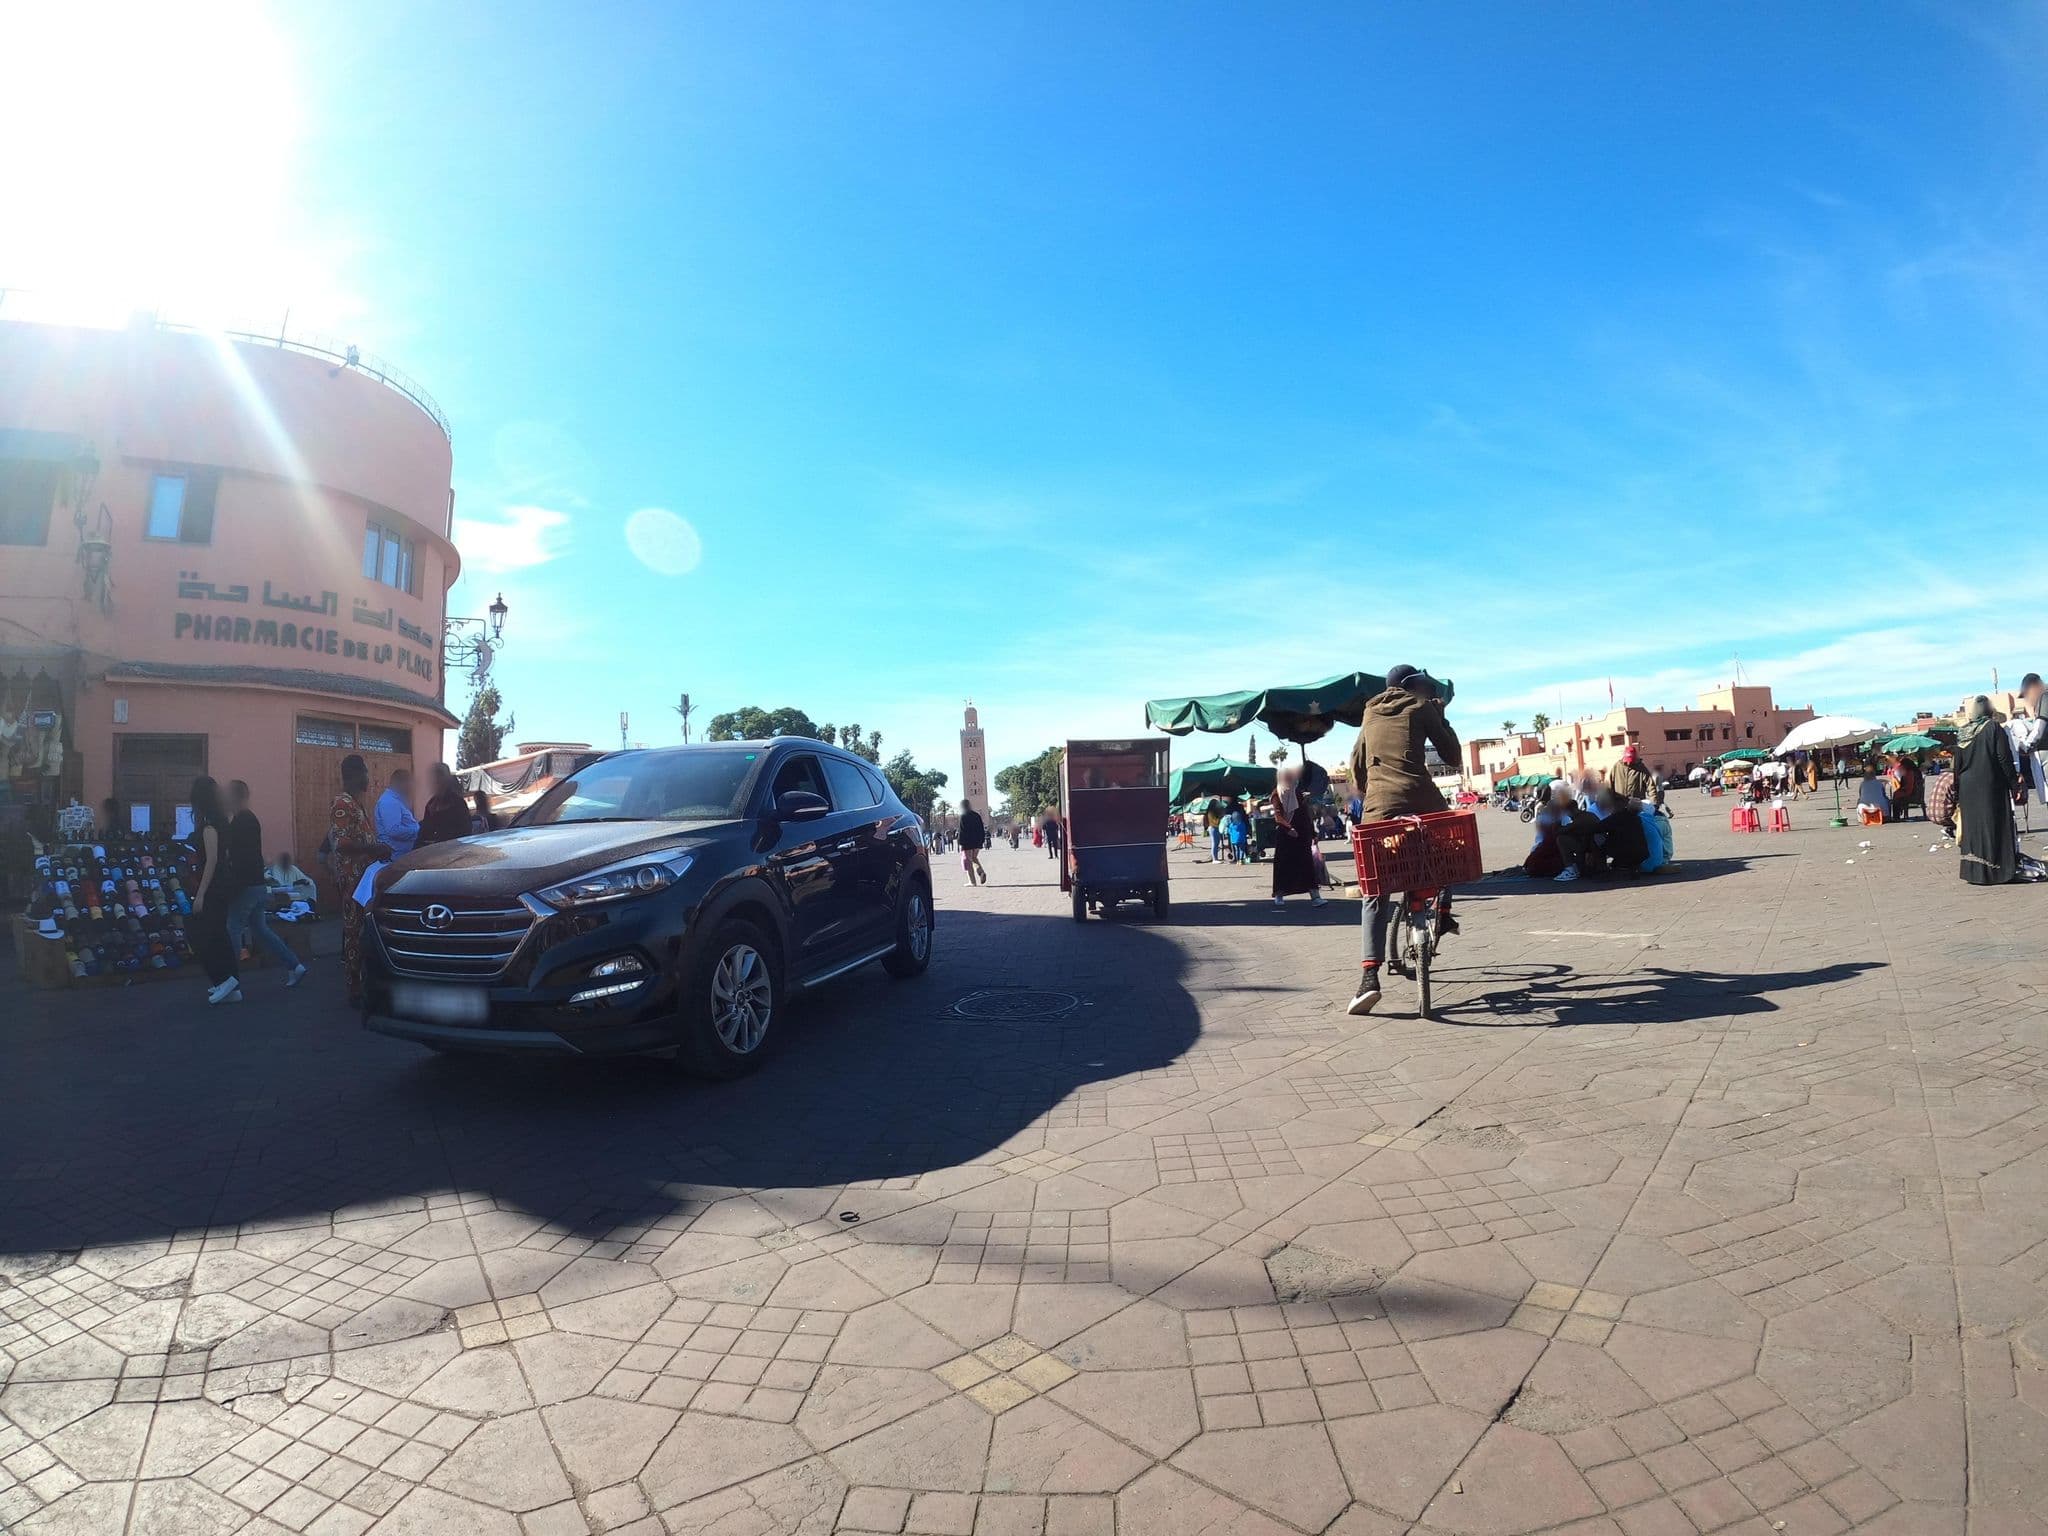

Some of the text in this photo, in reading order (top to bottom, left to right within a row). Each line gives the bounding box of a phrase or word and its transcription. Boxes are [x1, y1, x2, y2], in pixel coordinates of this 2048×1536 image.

[175, 612, 432, 681] PHARMACIE DE LA PLACE
